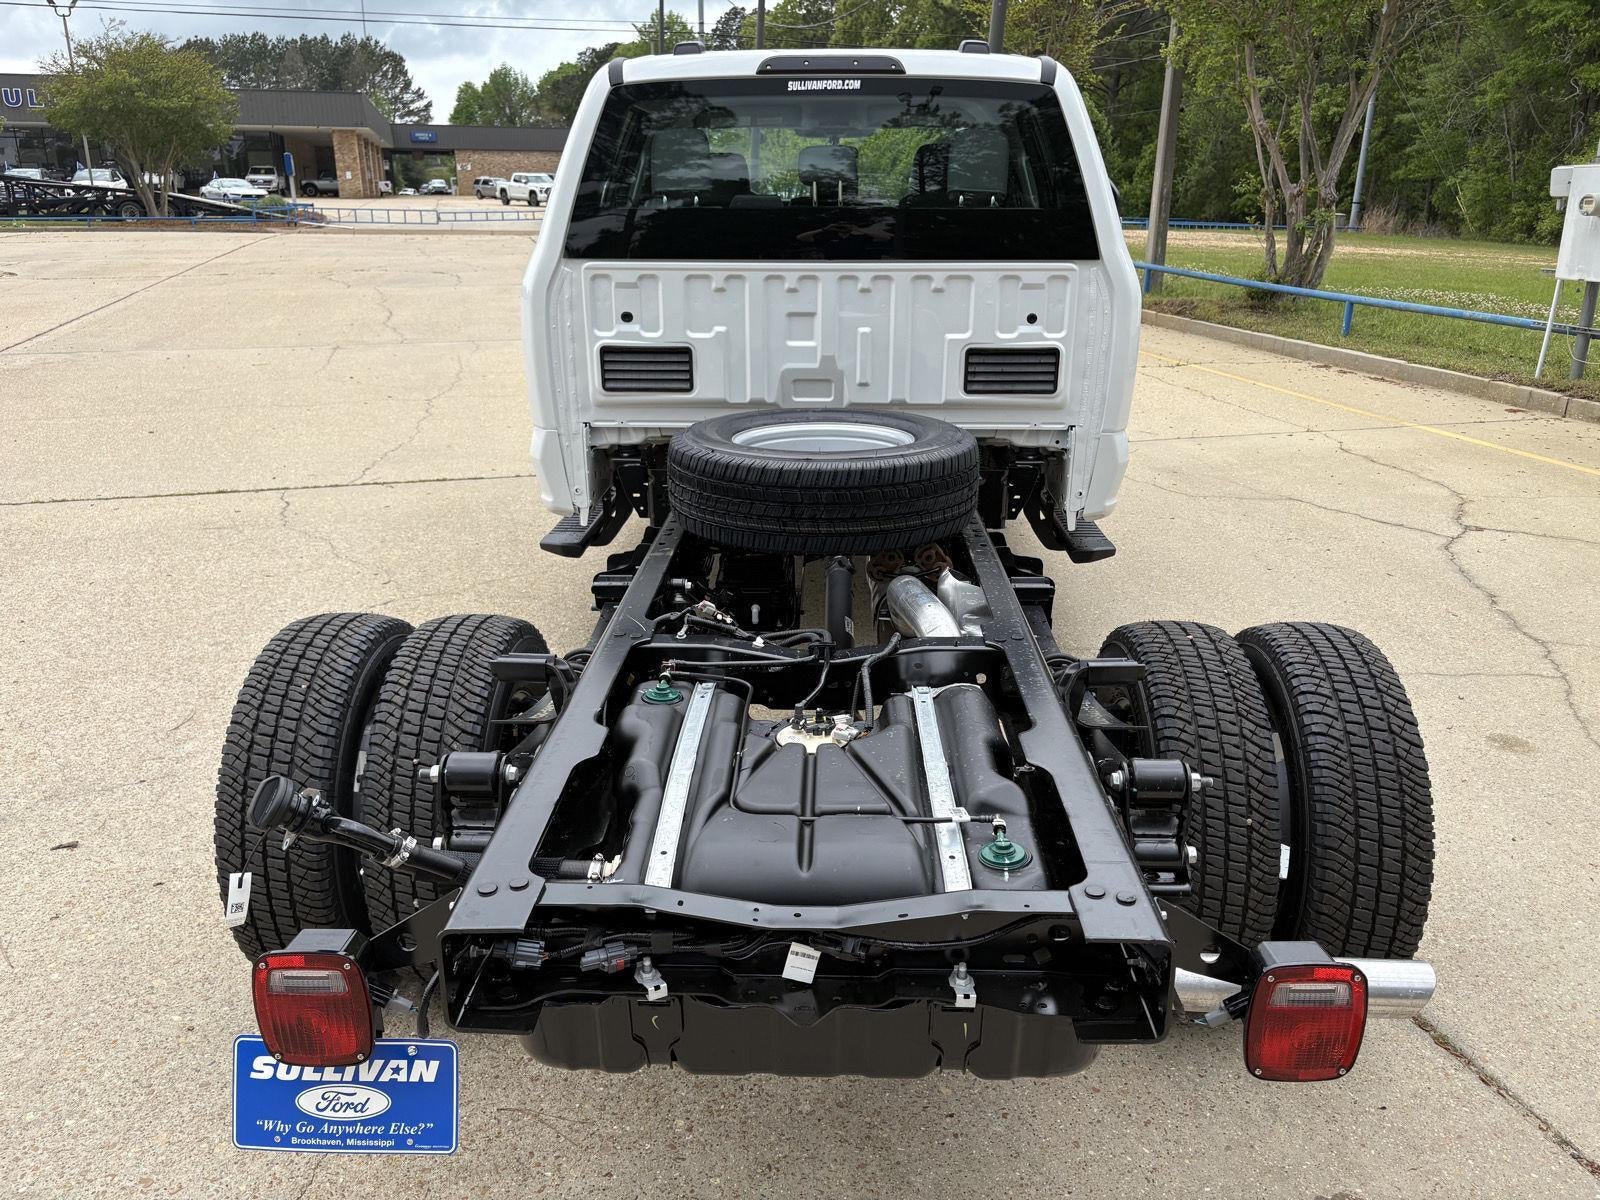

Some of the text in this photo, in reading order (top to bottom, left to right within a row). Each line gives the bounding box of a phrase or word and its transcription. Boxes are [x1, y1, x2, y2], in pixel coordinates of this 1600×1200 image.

[787, 80, 861, 91] SULLIVANFORD.COM
[250, 1055, 440, 1082] SULLIVAN
[315, 1090, 371, 1114] Ford
[295, 1121, 315, 1134] Go
[318, 1122, 385, 1137] Anywhere
[291, 1136, 395, 1148] Brookhaven, Mississippi
